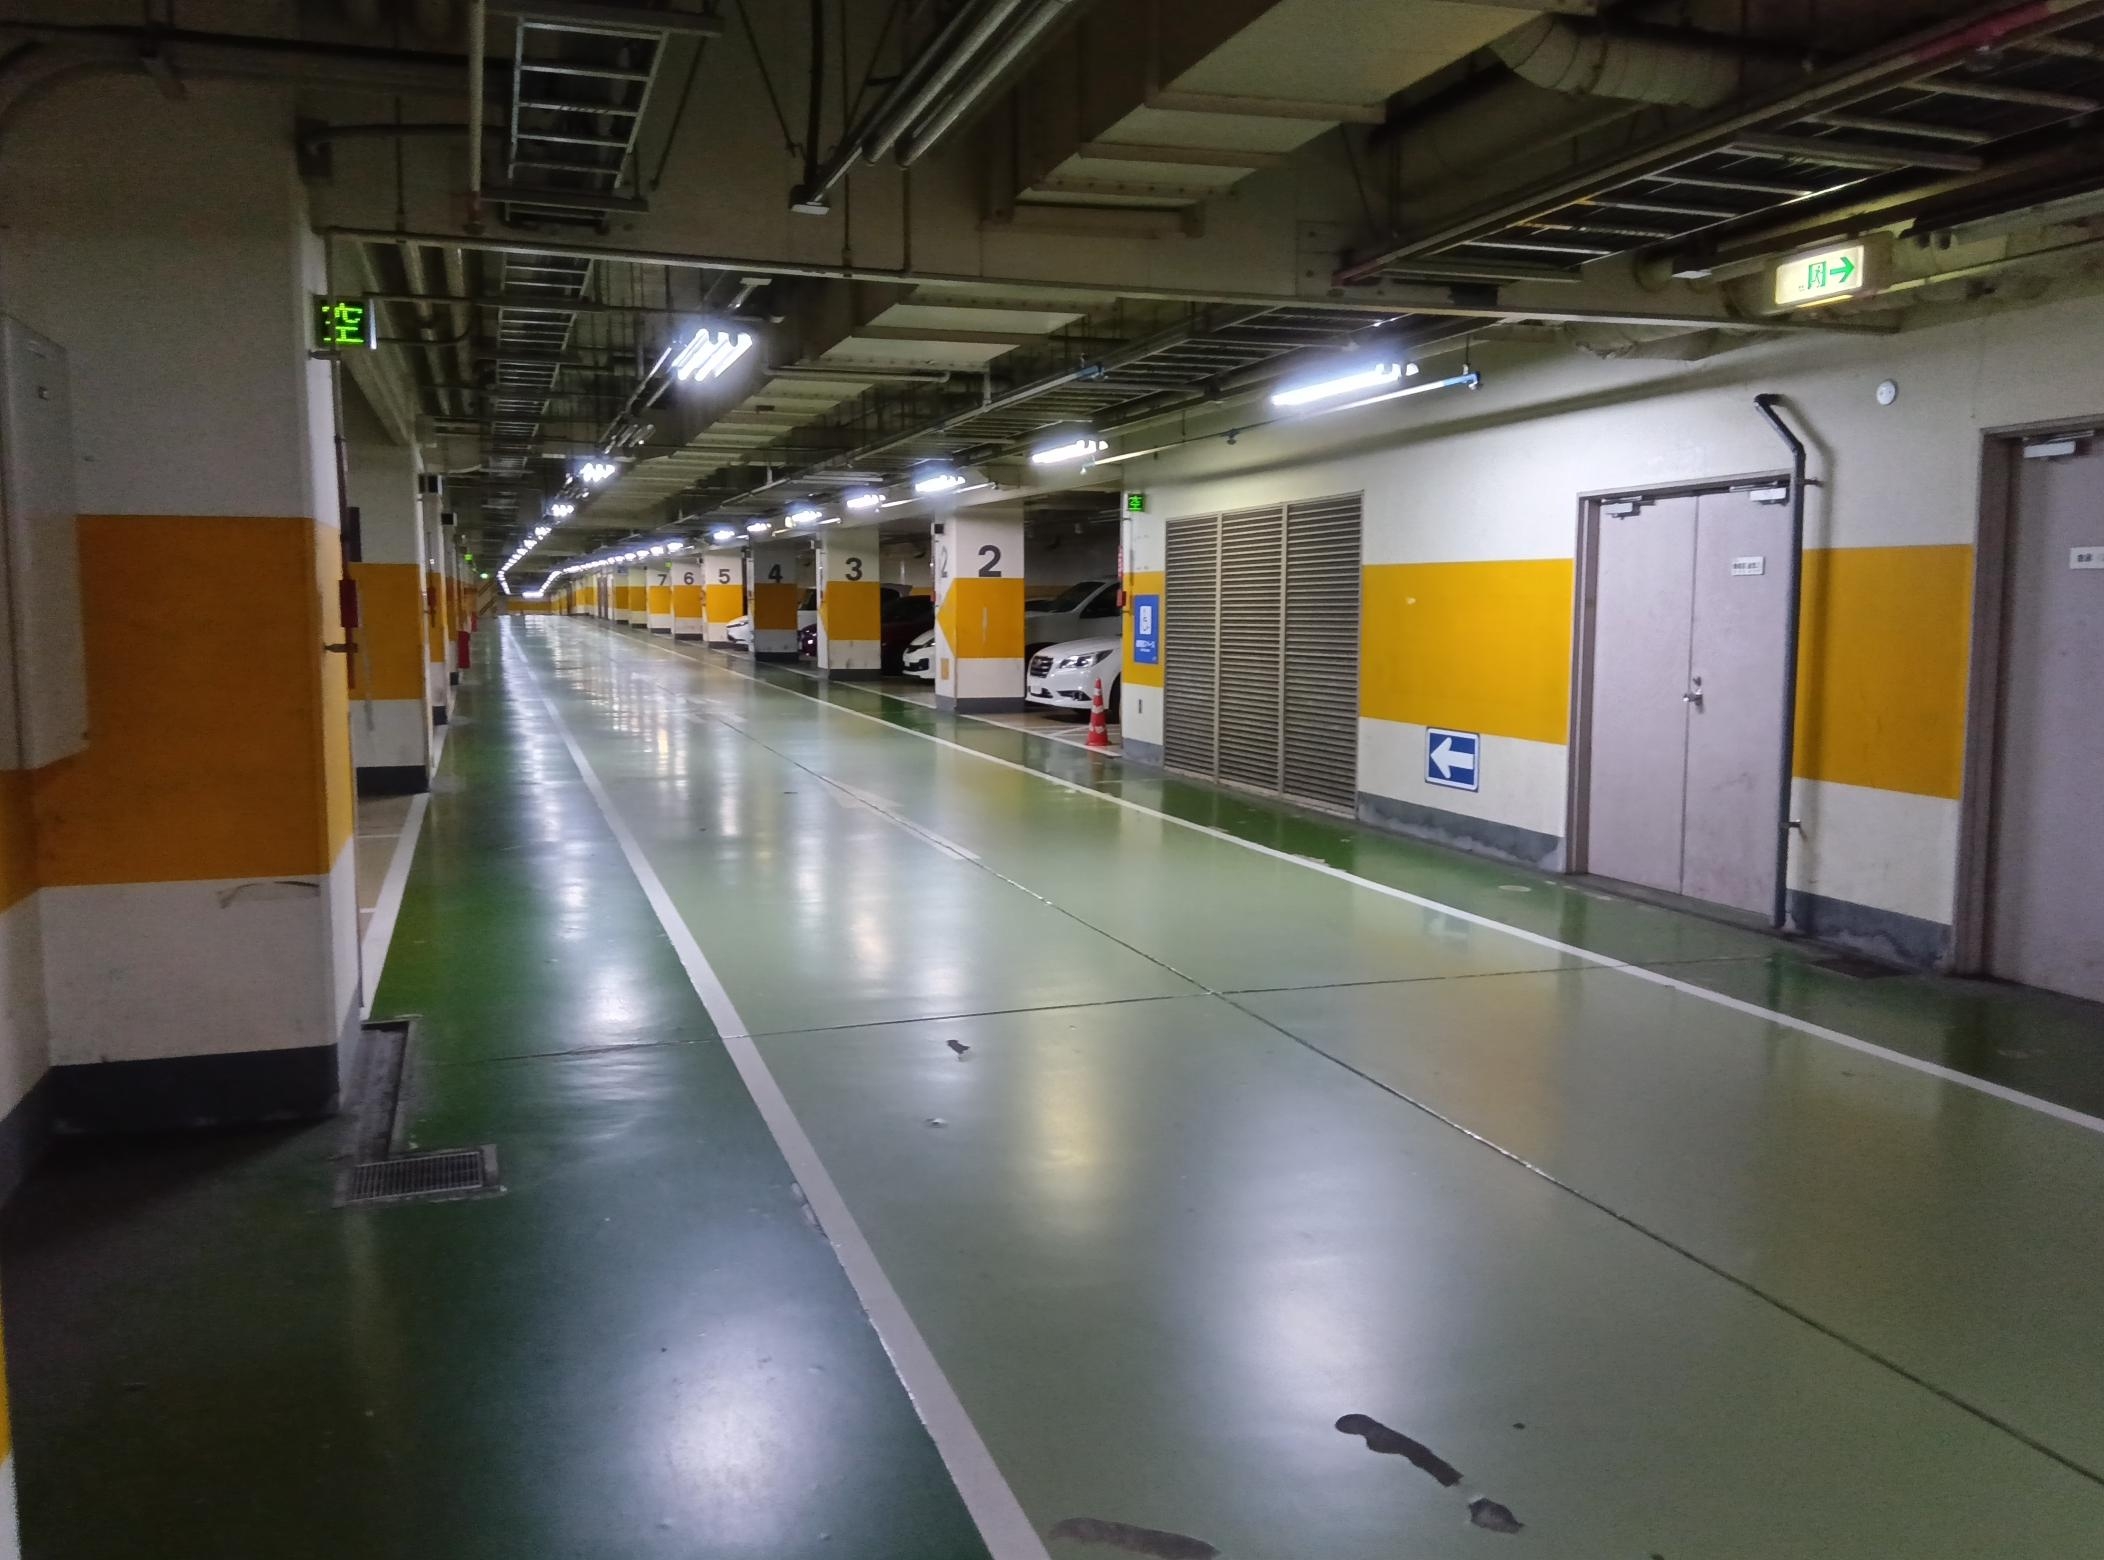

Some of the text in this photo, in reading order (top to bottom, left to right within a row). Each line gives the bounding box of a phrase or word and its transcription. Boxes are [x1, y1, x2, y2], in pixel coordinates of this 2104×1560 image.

[322, 303, 365, 342] 空
[845, 557, 863, 581] 3
[978, 545, 1002, 577] 2
[657, 574, 667, 586] 7
[683, 572, 694, 585] 6
[718, 569, 730, 584] 5
[768, 563, 783, 583] 4
